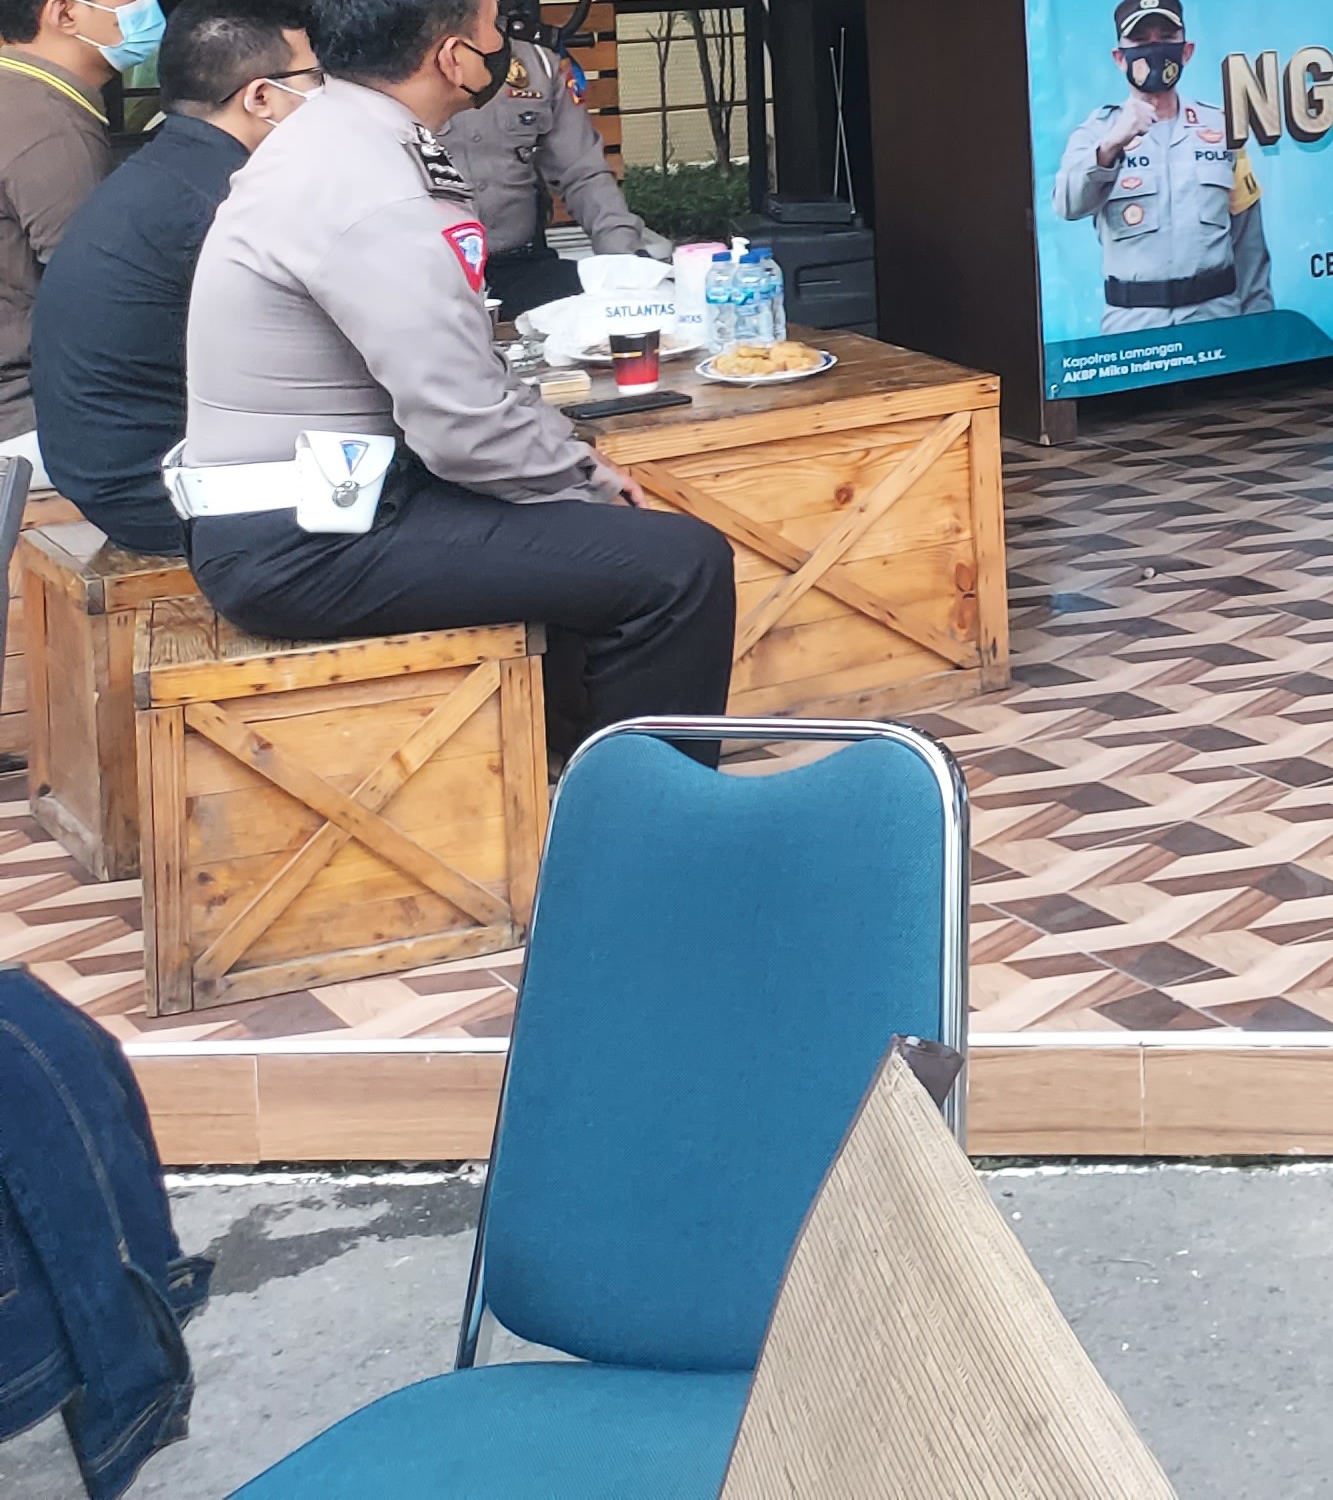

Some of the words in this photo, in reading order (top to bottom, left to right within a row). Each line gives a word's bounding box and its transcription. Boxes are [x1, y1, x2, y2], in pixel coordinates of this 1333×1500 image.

[605, 302, 676, 319] SATLANTAS
[1062, 352, 1118, 369] Kapolres
[1119, 342, 1183, 360] Lamongan
[1063, 369, 1098, 383] AKBP
